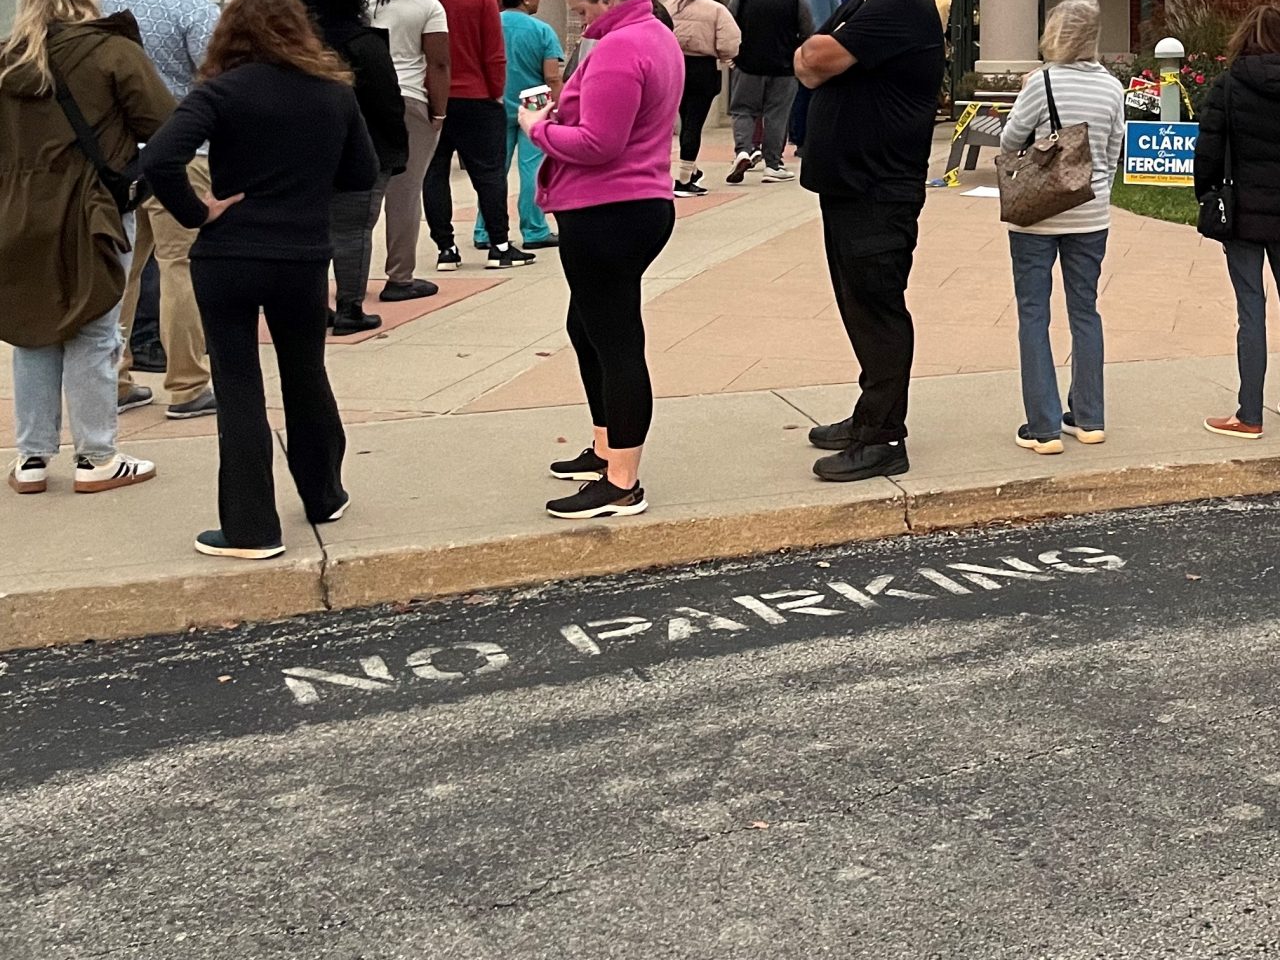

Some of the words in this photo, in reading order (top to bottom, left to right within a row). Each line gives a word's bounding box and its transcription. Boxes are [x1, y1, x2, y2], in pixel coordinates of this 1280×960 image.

[1139, 135, 1195, 150] CLARK
[1128, 158, 1193, 173] FERCHMI
[281, 641, 510, 705] NO
[559, 546, 1127, 655] PARKING
